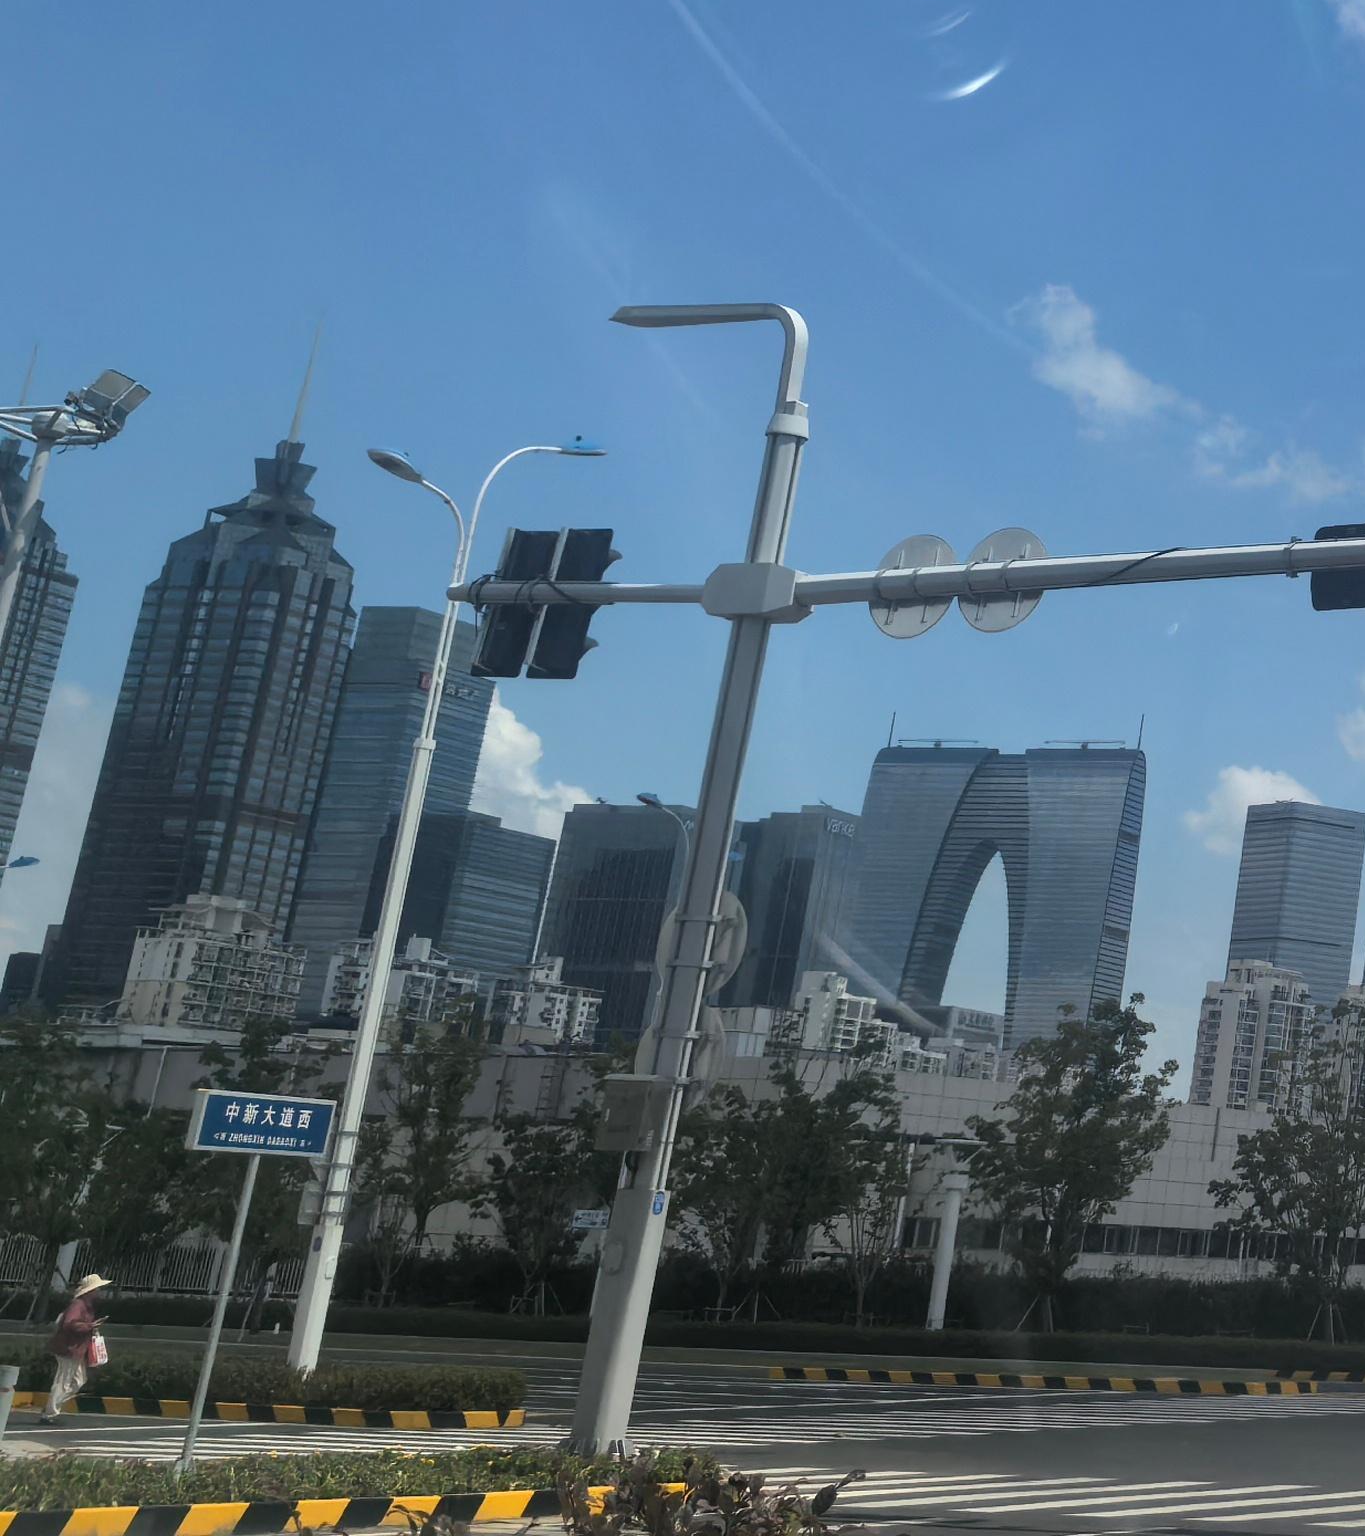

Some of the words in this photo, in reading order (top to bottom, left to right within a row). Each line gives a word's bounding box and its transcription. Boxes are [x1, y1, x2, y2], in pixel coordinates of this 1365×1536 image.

[225, 1101, 313, 1129] 中新大道西
[228, 1132, 265, 1144] ZHONGXIN
